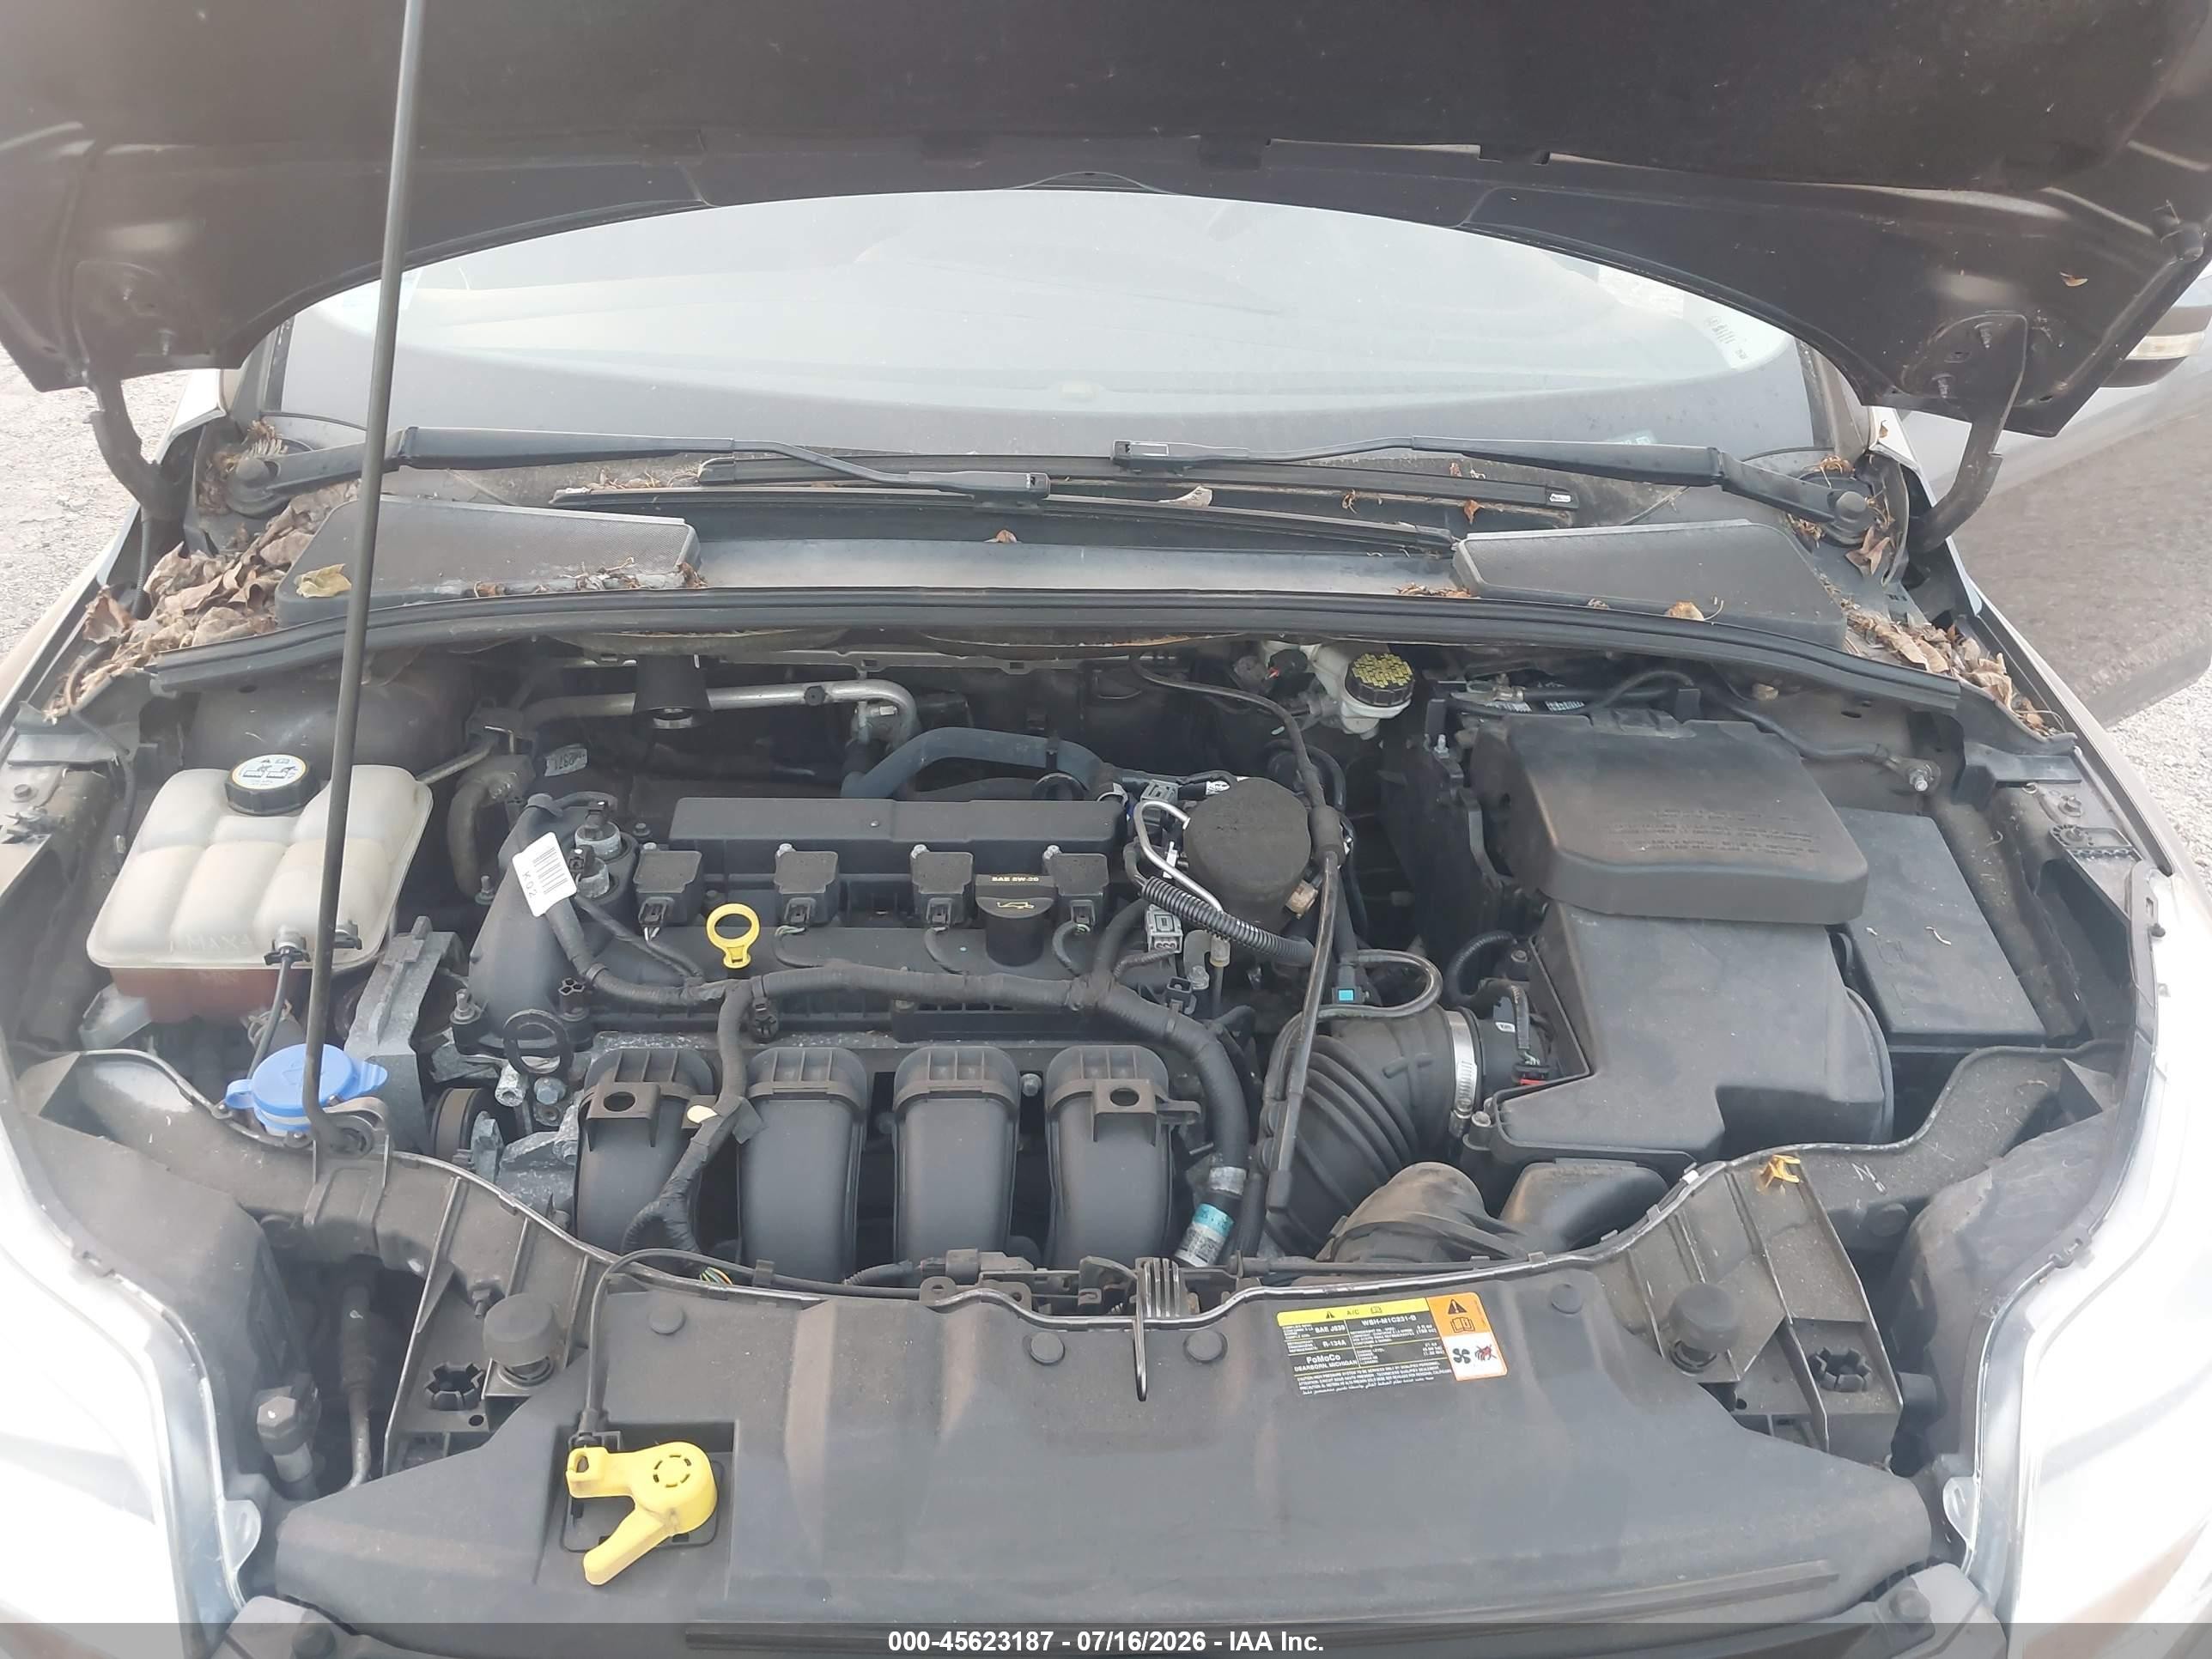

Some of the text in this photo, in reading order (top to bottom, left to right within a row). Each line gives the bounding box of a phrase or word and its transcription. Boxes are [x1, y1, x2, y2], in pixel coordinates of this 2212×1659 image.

[1322, 1338, 1347, 1348] R-134A
[1306, 1353, 1341, 1364] FoMoCo
[1329, 1358, 1358, 1368] MICHIGAN
